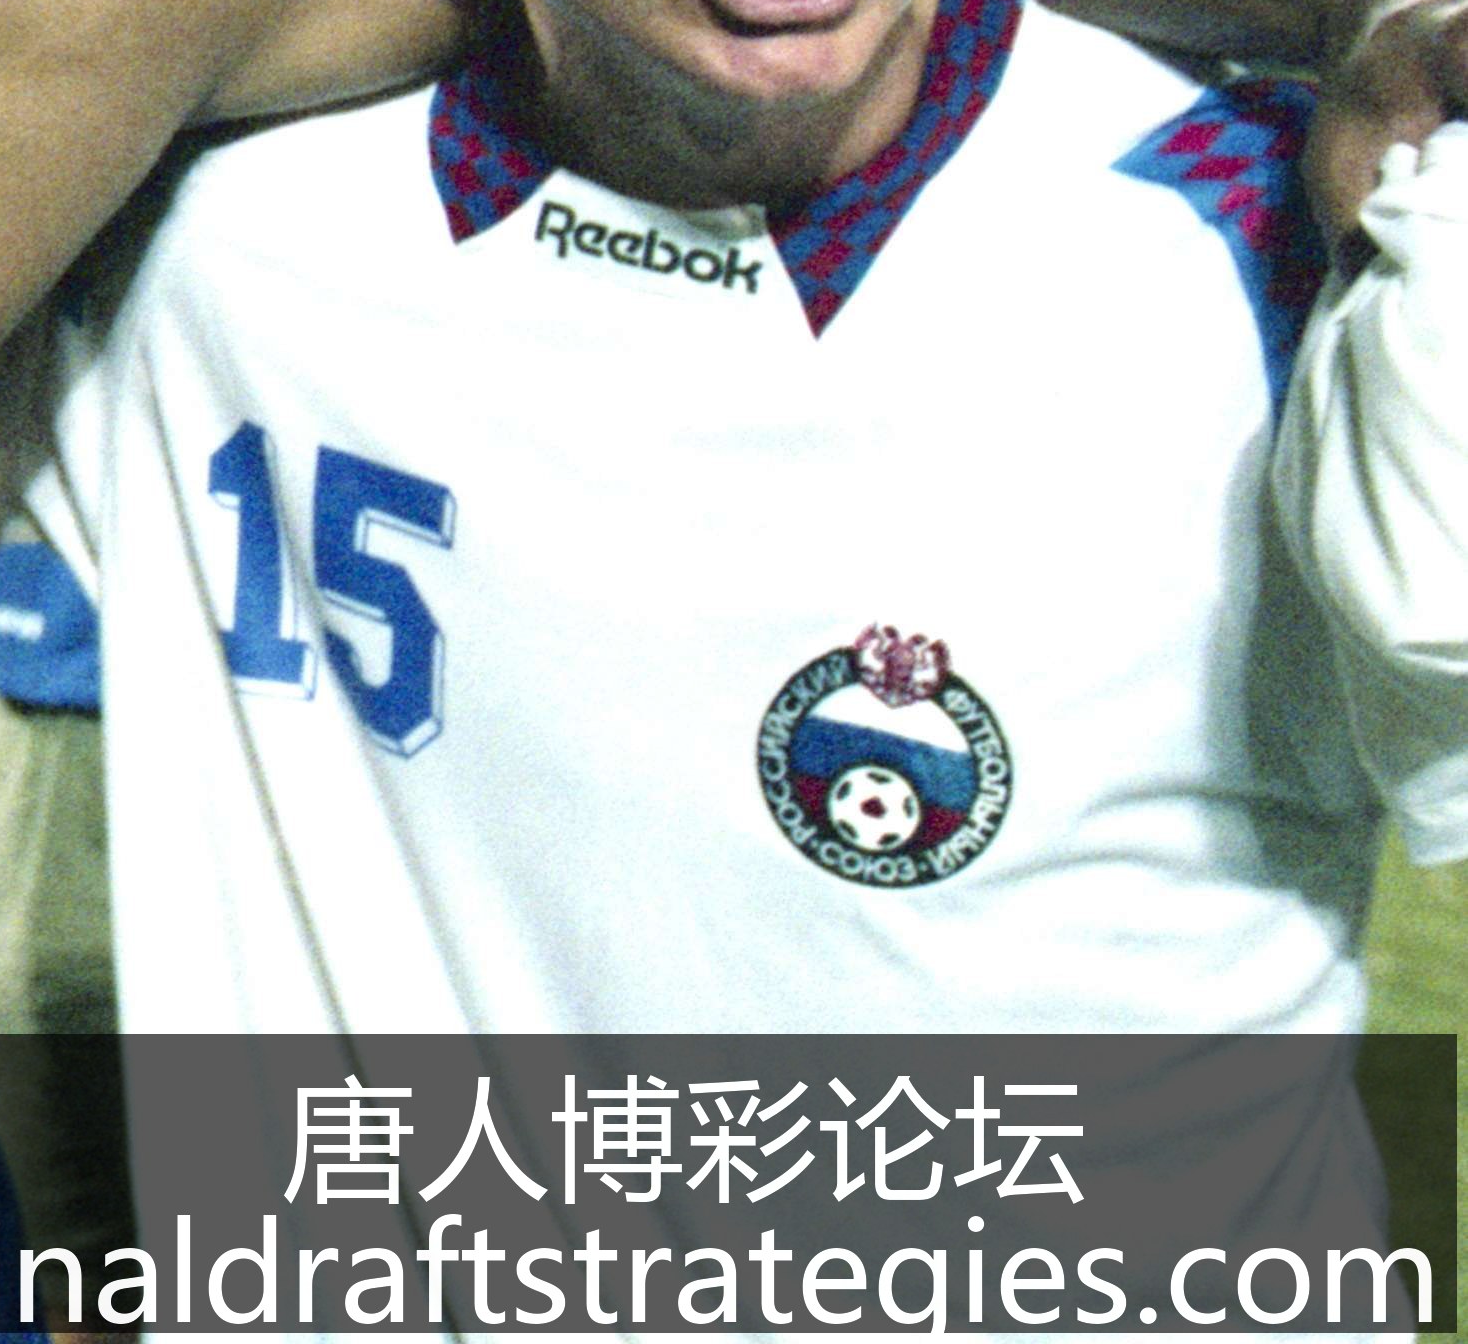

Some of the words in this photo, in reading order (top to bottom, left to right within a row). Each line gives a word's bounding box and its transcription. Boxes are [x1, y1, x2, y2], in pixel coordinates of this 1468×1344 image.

[535, 201, 763, 294] Reebok
[208, 420, 457, 759] 15
[818, 841, 918, 883] СОЮЗ
